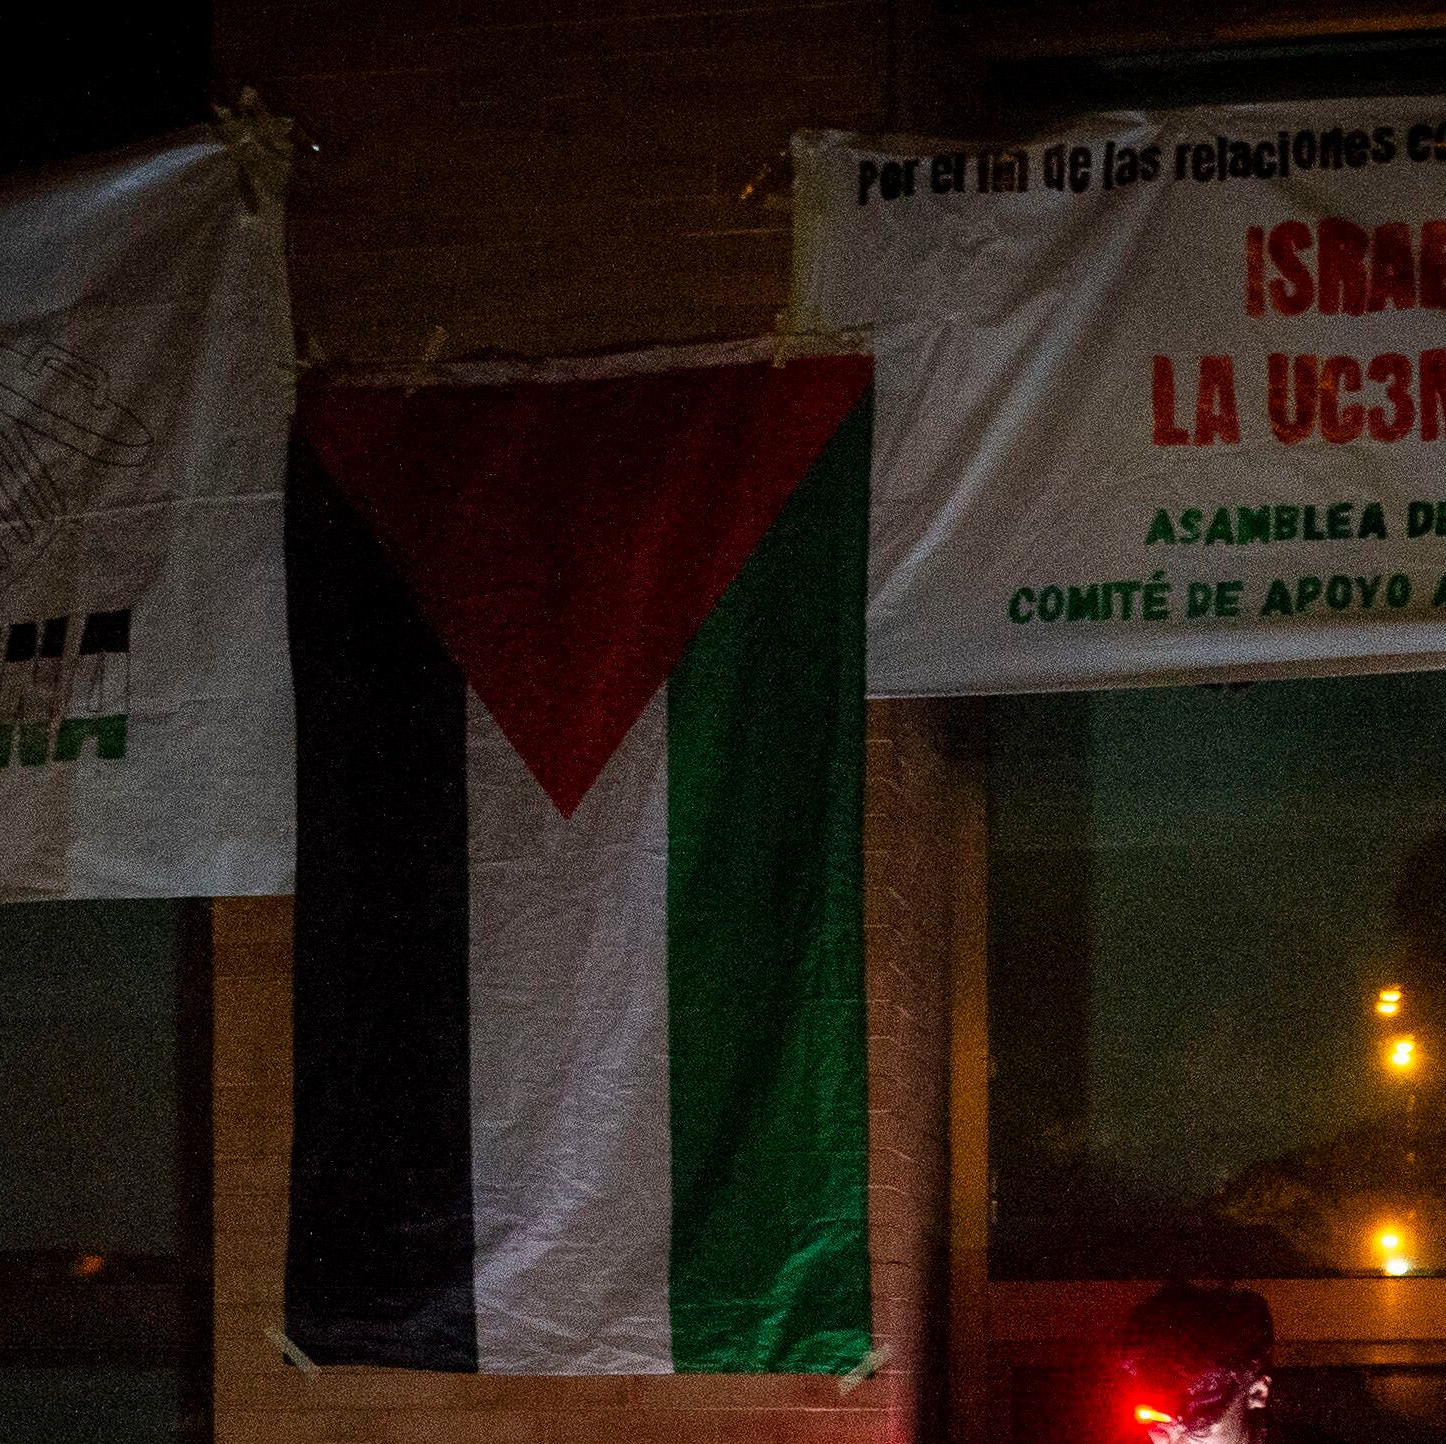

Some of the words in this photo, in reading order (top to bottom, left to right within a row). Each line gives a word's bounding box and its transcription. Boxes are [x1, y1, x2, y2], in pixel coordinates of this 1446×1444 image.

[932, 153, 965, 194] el
[1043, 144, 1091, 192] de
[1103, 141, 1160, 190] las
[1174, 124, 1396, 184] relaciones
[1151, 353, 1241, 446] LA
[1146, 501, 1388, 547] ASAMBLEA
[1007, 570, 1173, 625] COMITÉ
[1186, 580, 1245, 619] DE
[1260, 573, 1412, 618] APOYO
